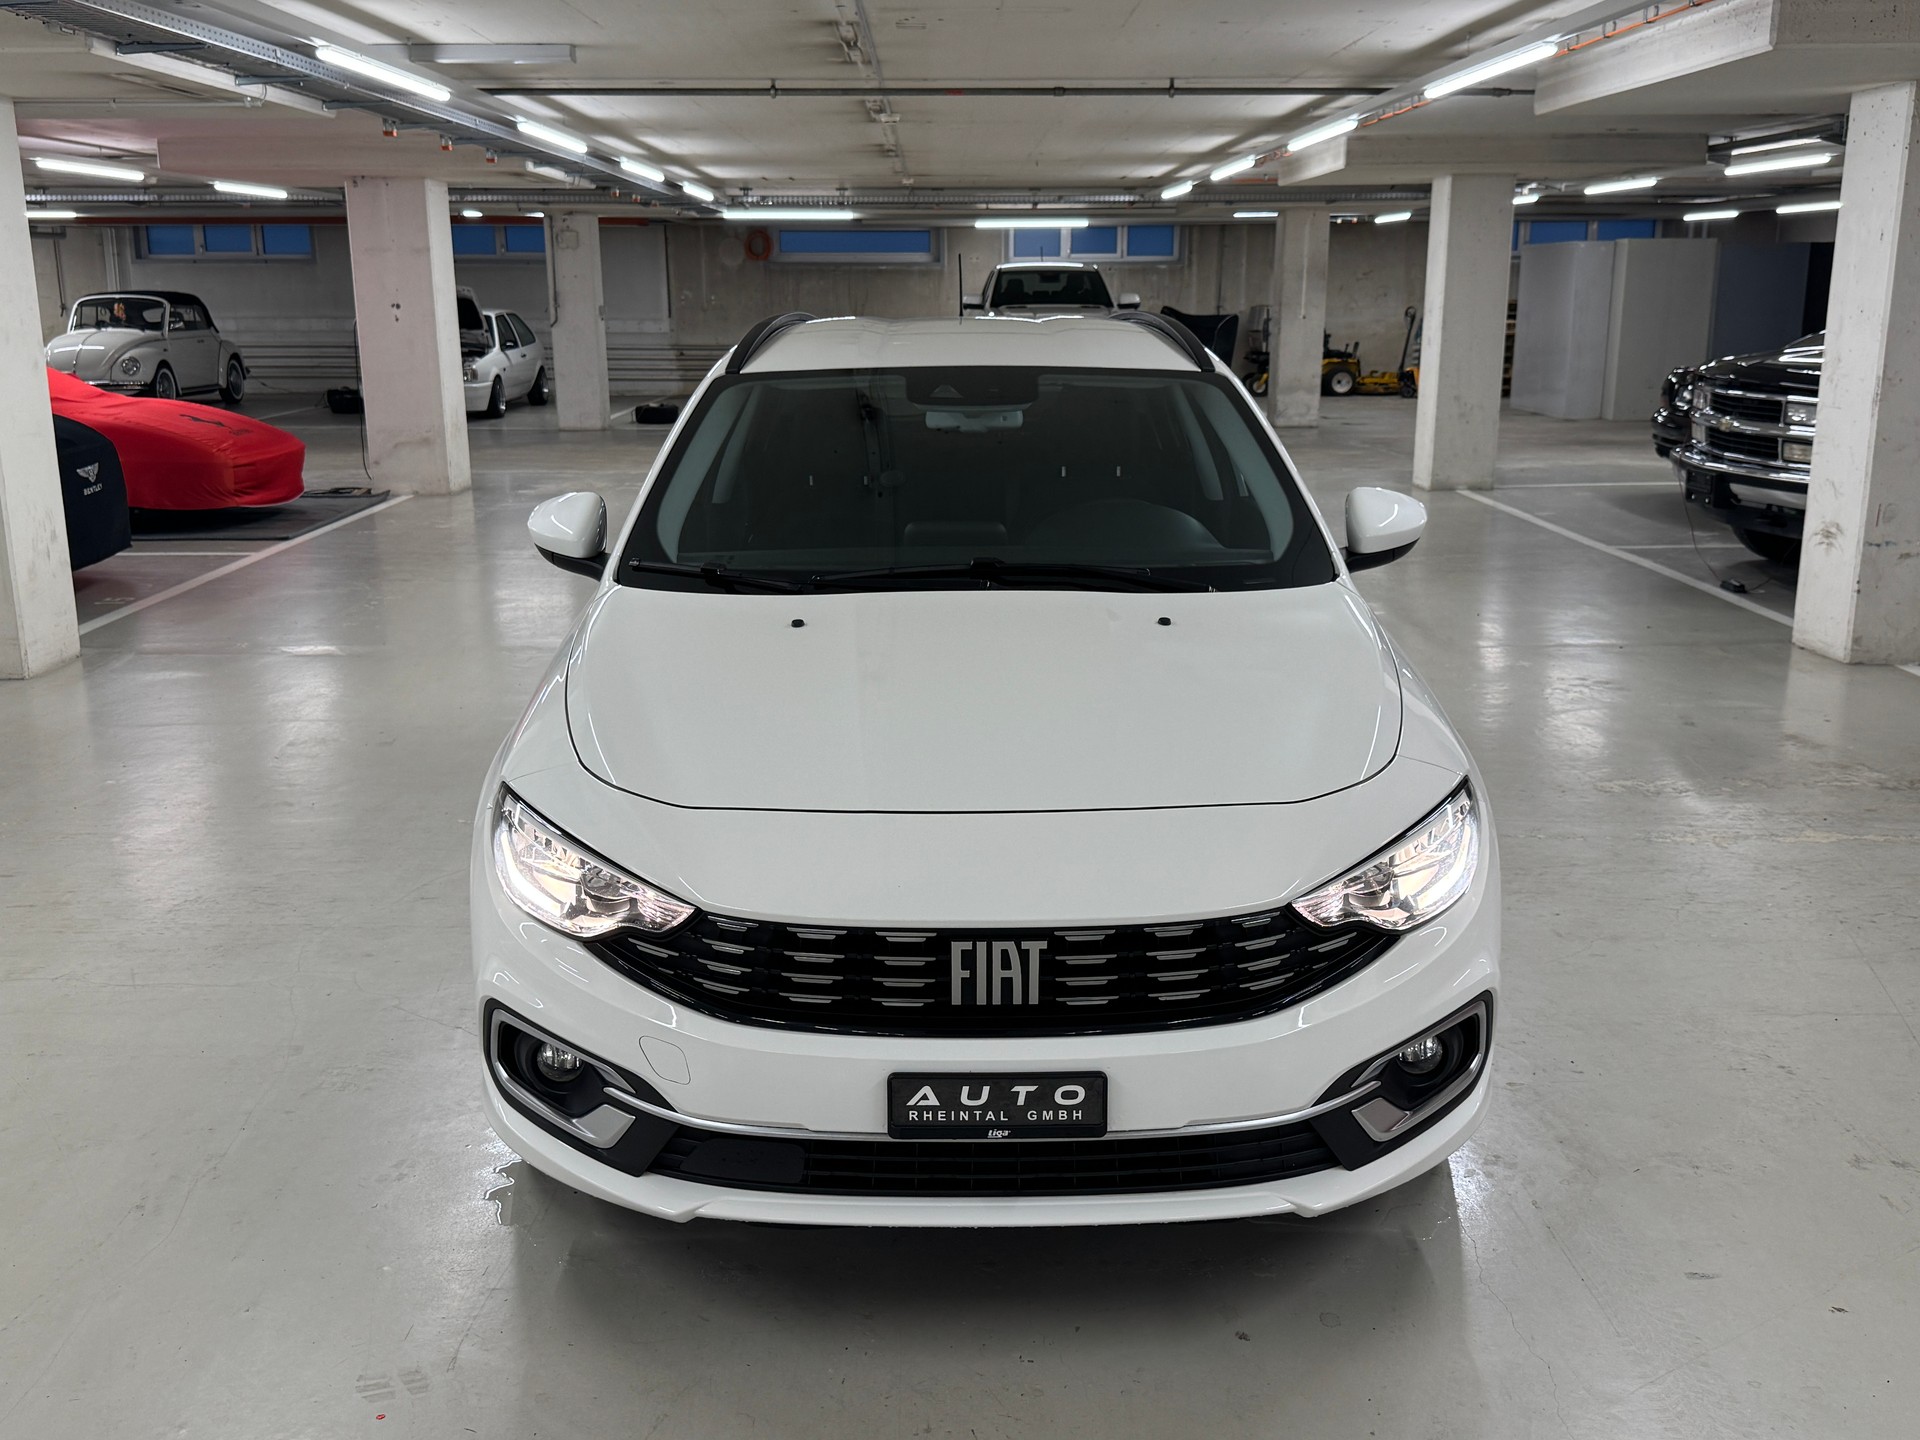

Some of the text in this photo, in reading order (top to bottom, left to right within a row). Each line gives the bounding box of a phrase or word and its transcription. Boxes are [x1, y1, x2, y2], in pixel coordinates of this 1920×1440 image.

[83, 483, 103, 496] BENTLEY
[951, 940, 1048, 1005] FIAT
[906, 1084, 1086, 1106] AUTO
[908, 1110, 1083, 1121] RHEINTAL GMBH
